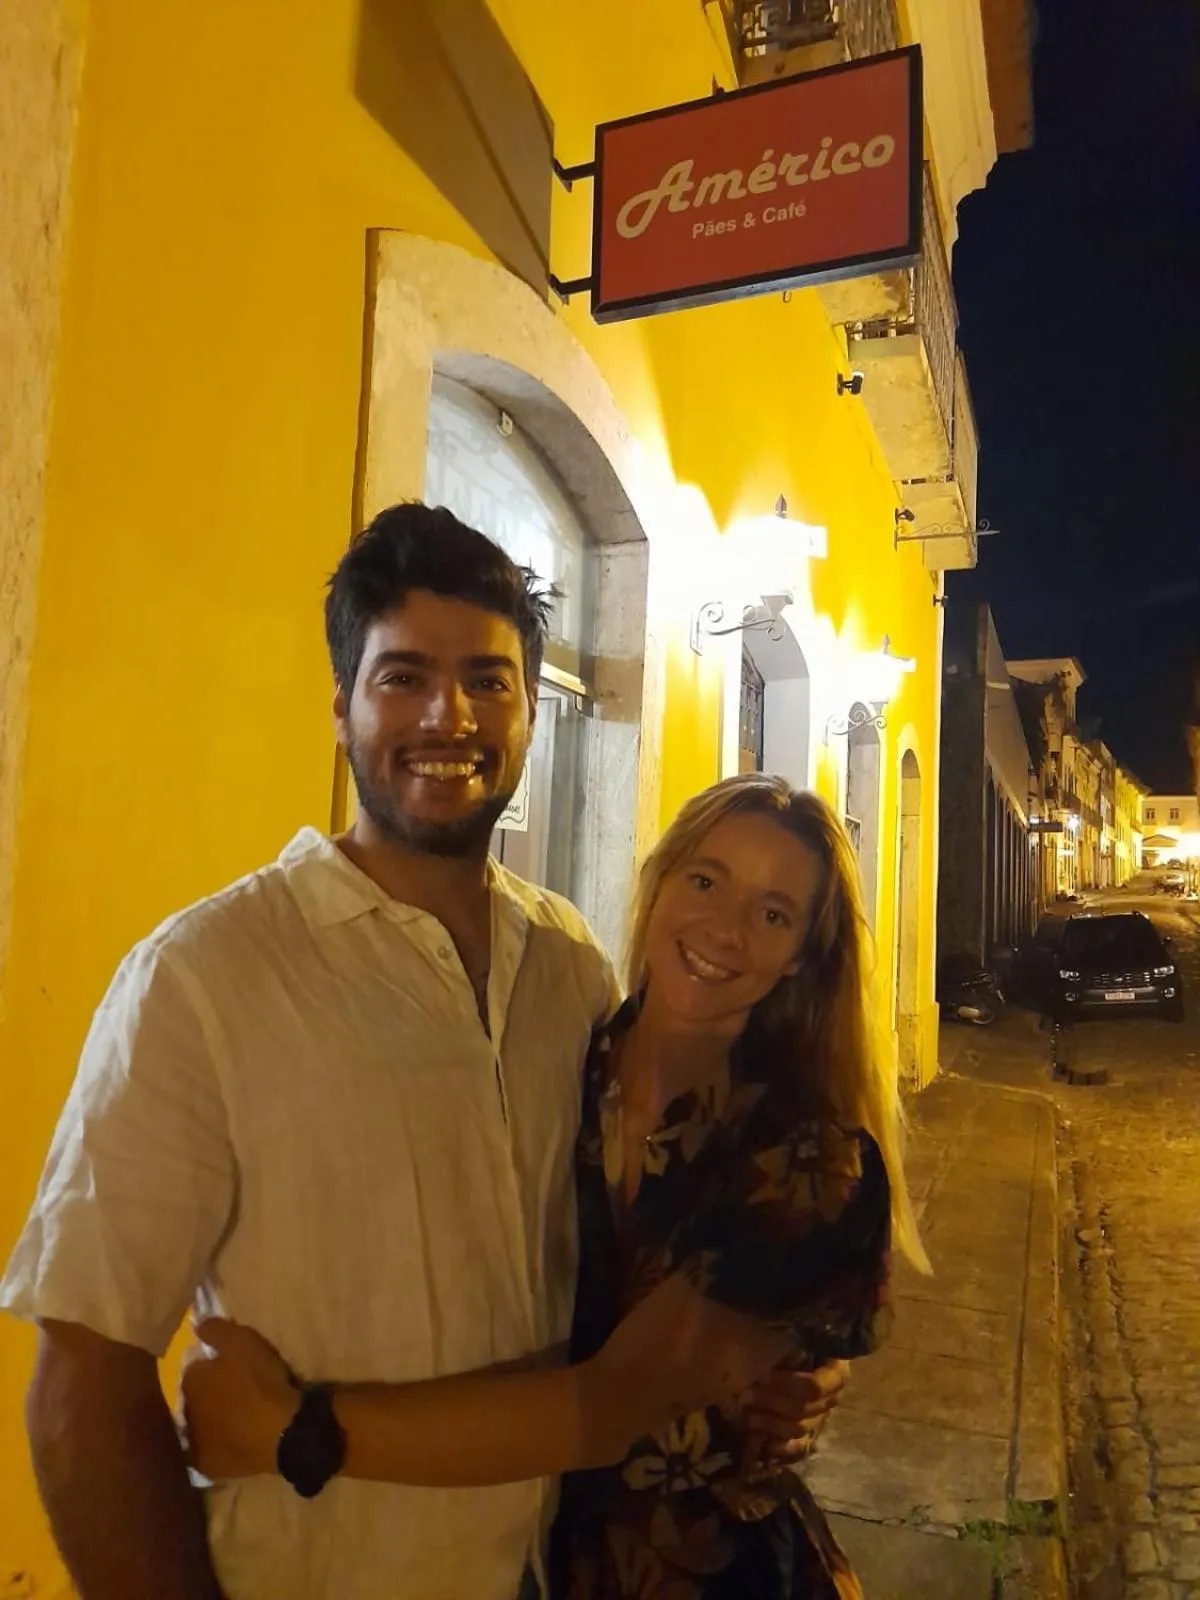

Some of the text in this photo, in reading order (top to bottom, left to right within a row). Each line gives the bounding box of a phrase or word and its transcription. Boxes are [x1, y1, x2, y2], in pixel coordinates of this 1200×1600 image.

[616, 135, 895, 238] Américo
[692, 200, 807, 239] Pães & Café
